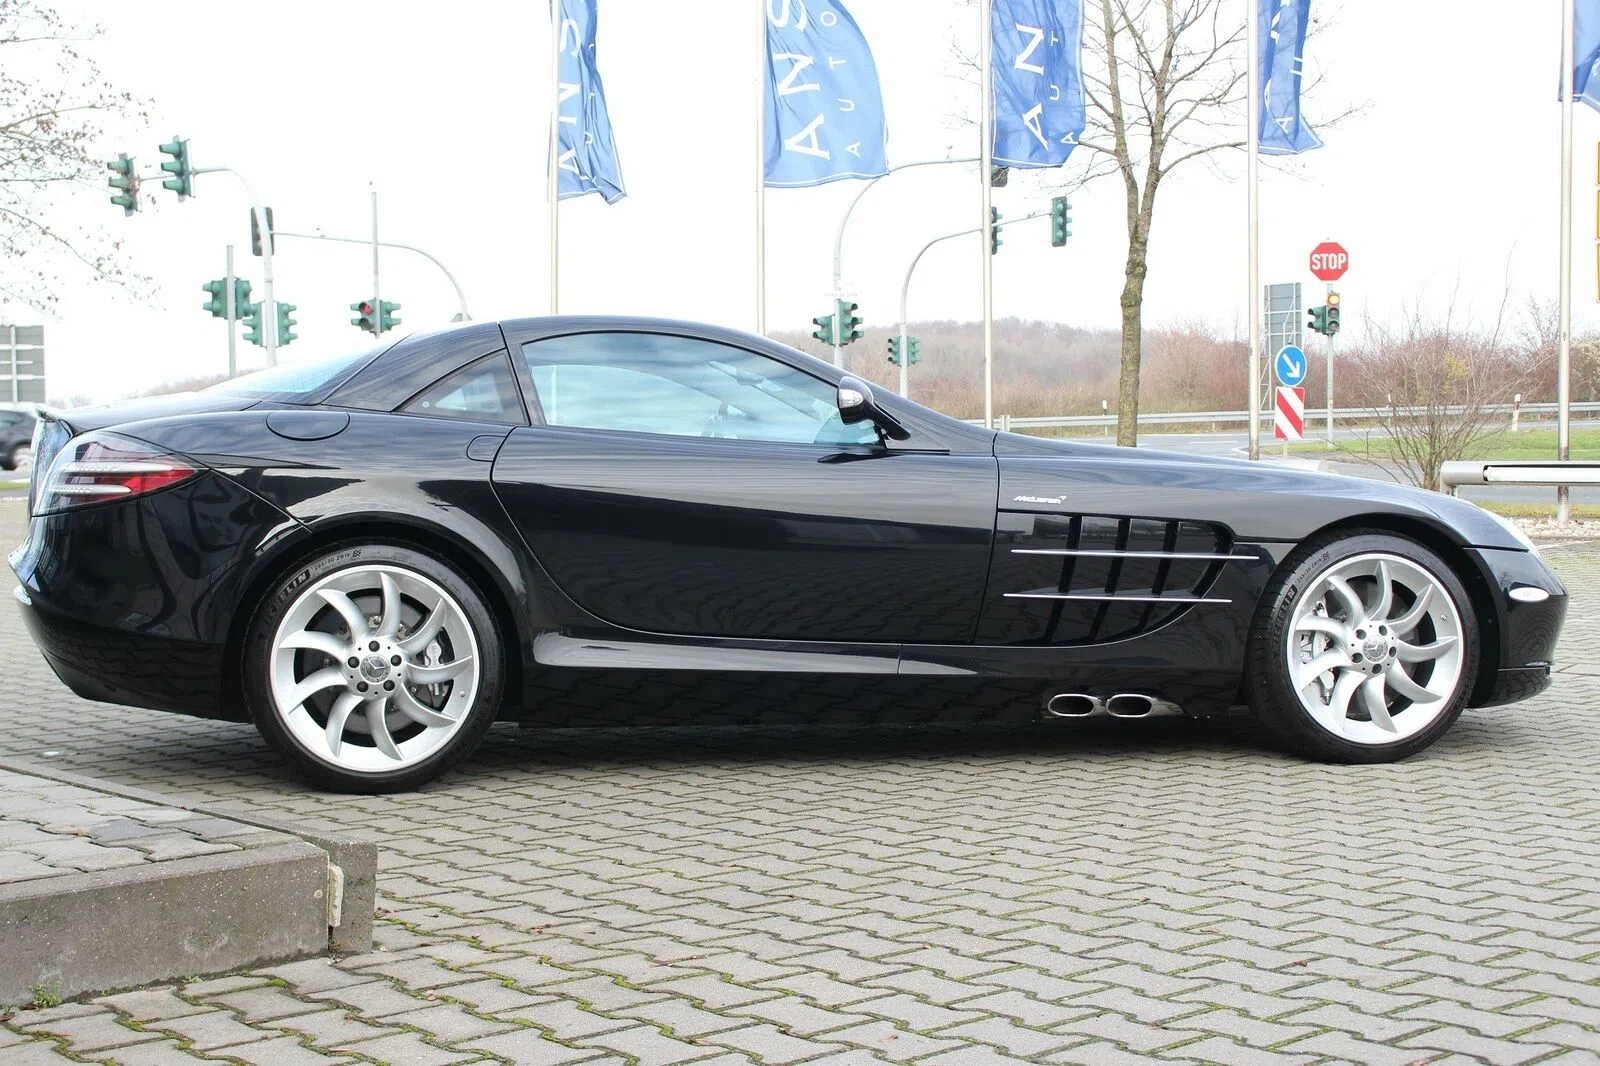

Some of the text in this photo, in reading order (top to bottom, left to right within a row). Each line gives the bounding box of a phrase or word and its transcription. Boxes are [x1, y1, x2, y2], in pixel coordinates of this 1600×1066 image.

[820, 11, 862, 158] AUTO
[1311, 253, 1347, 271] STOP
[260, 571, 309, 632] ICHELIN
